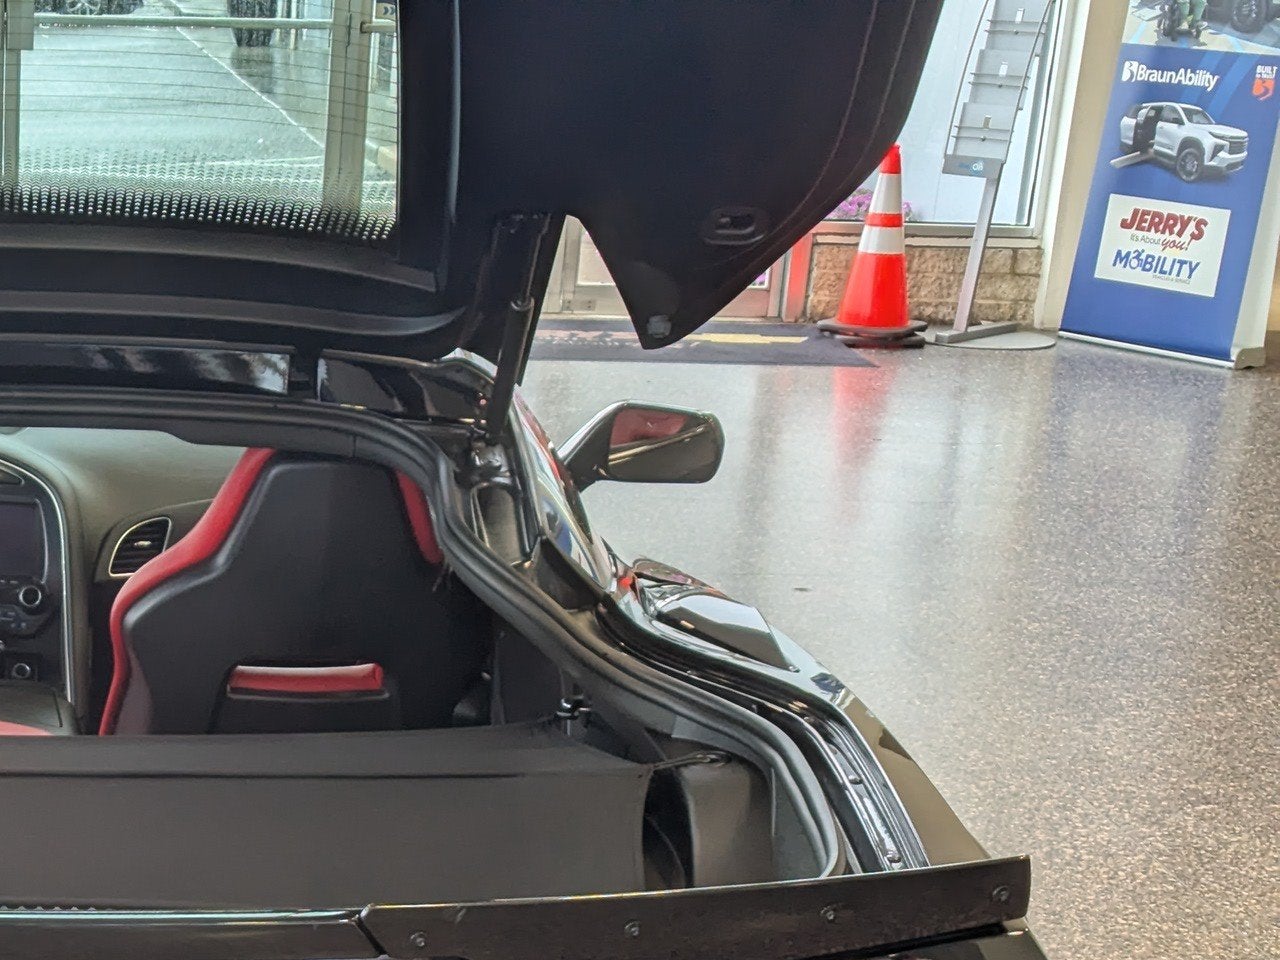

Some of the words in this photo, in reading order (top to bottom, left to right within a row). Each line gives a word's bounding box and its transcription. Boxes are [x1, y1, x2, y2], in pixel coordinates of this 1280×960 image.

[1136, 64, 1219, 92] BraunAbility
[1120, 207, 1209, 241] JERRY'S
[1139, 235, 1161, 245] About
[1161, 237, 1191, 251] you!
